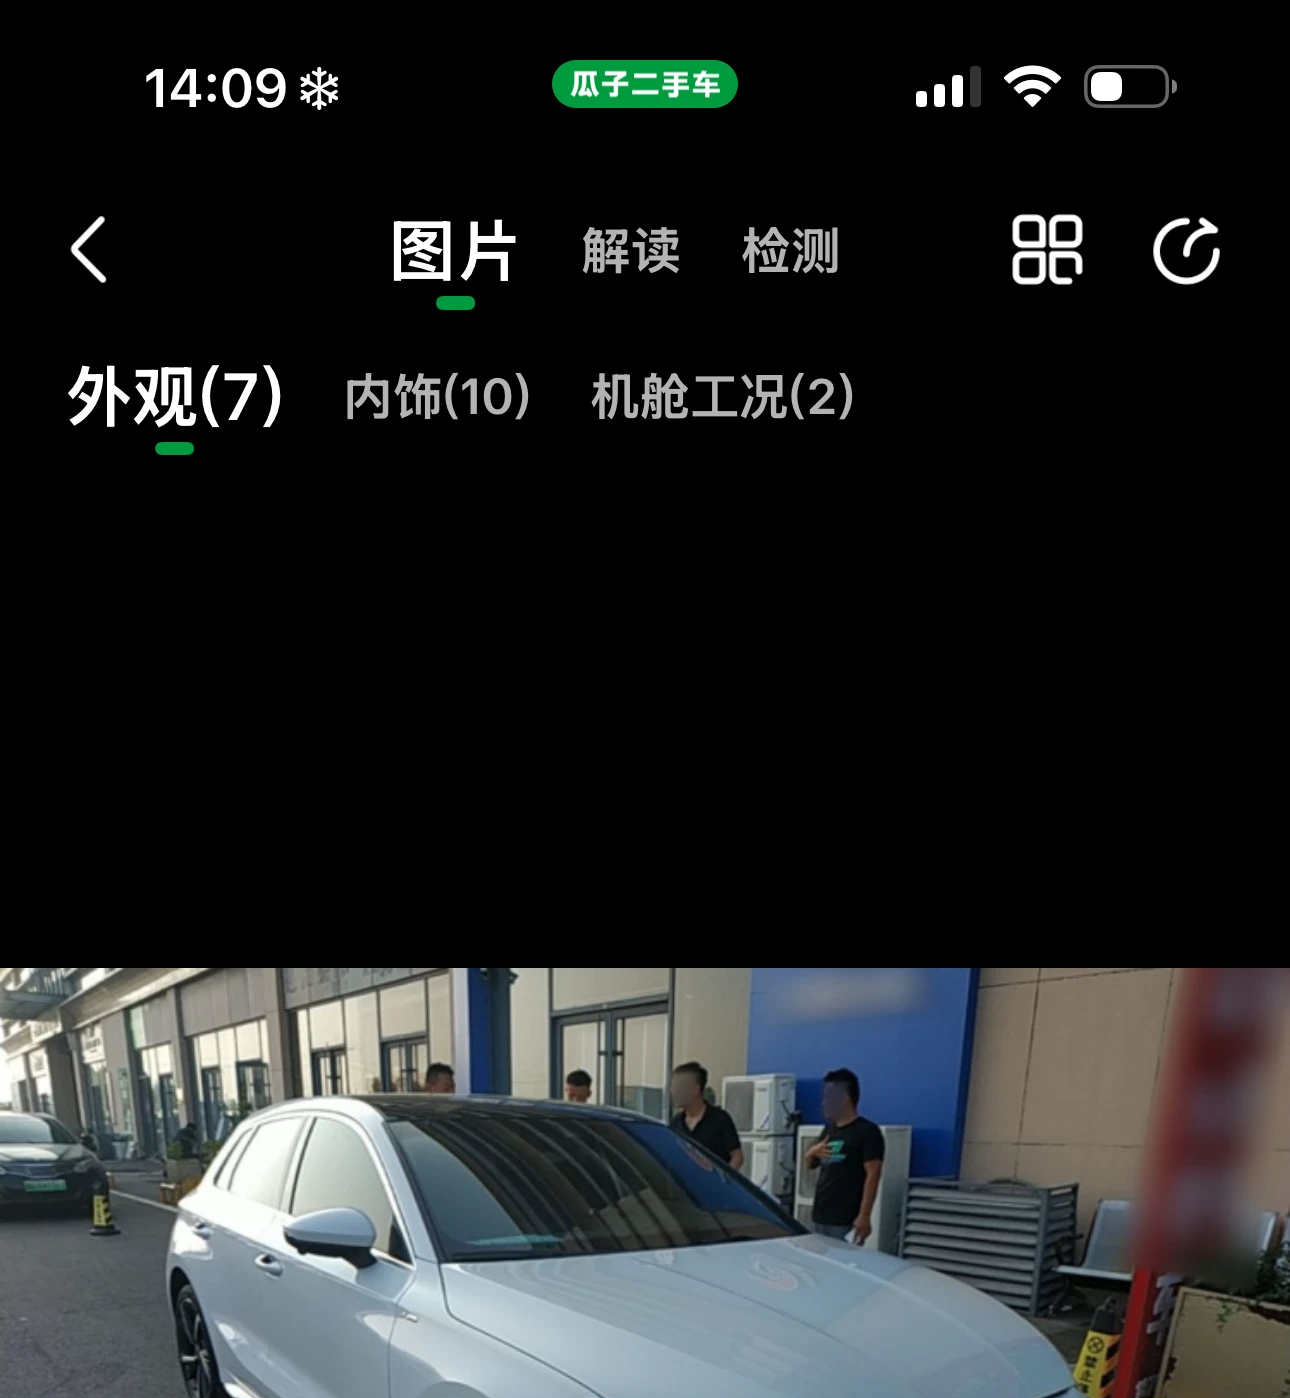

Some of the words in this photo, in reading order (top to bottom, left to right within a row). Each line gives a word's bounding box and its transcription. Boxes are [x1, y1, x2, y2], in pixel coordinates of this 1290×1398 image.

[146, 68, 286, 108] 14:09
[571, 70, 720, 98] 瓜子二手车
[394, 219, 516, 281] 图片
[583, 227, 679, 273] 解读
[742, 227, 838, 273] 检测
[68, 365, 281, 427] 外观(7)
[347, 373, 528, 419] 内饰(10)
[592, 373, 852, 419] 机舱工况(2)
